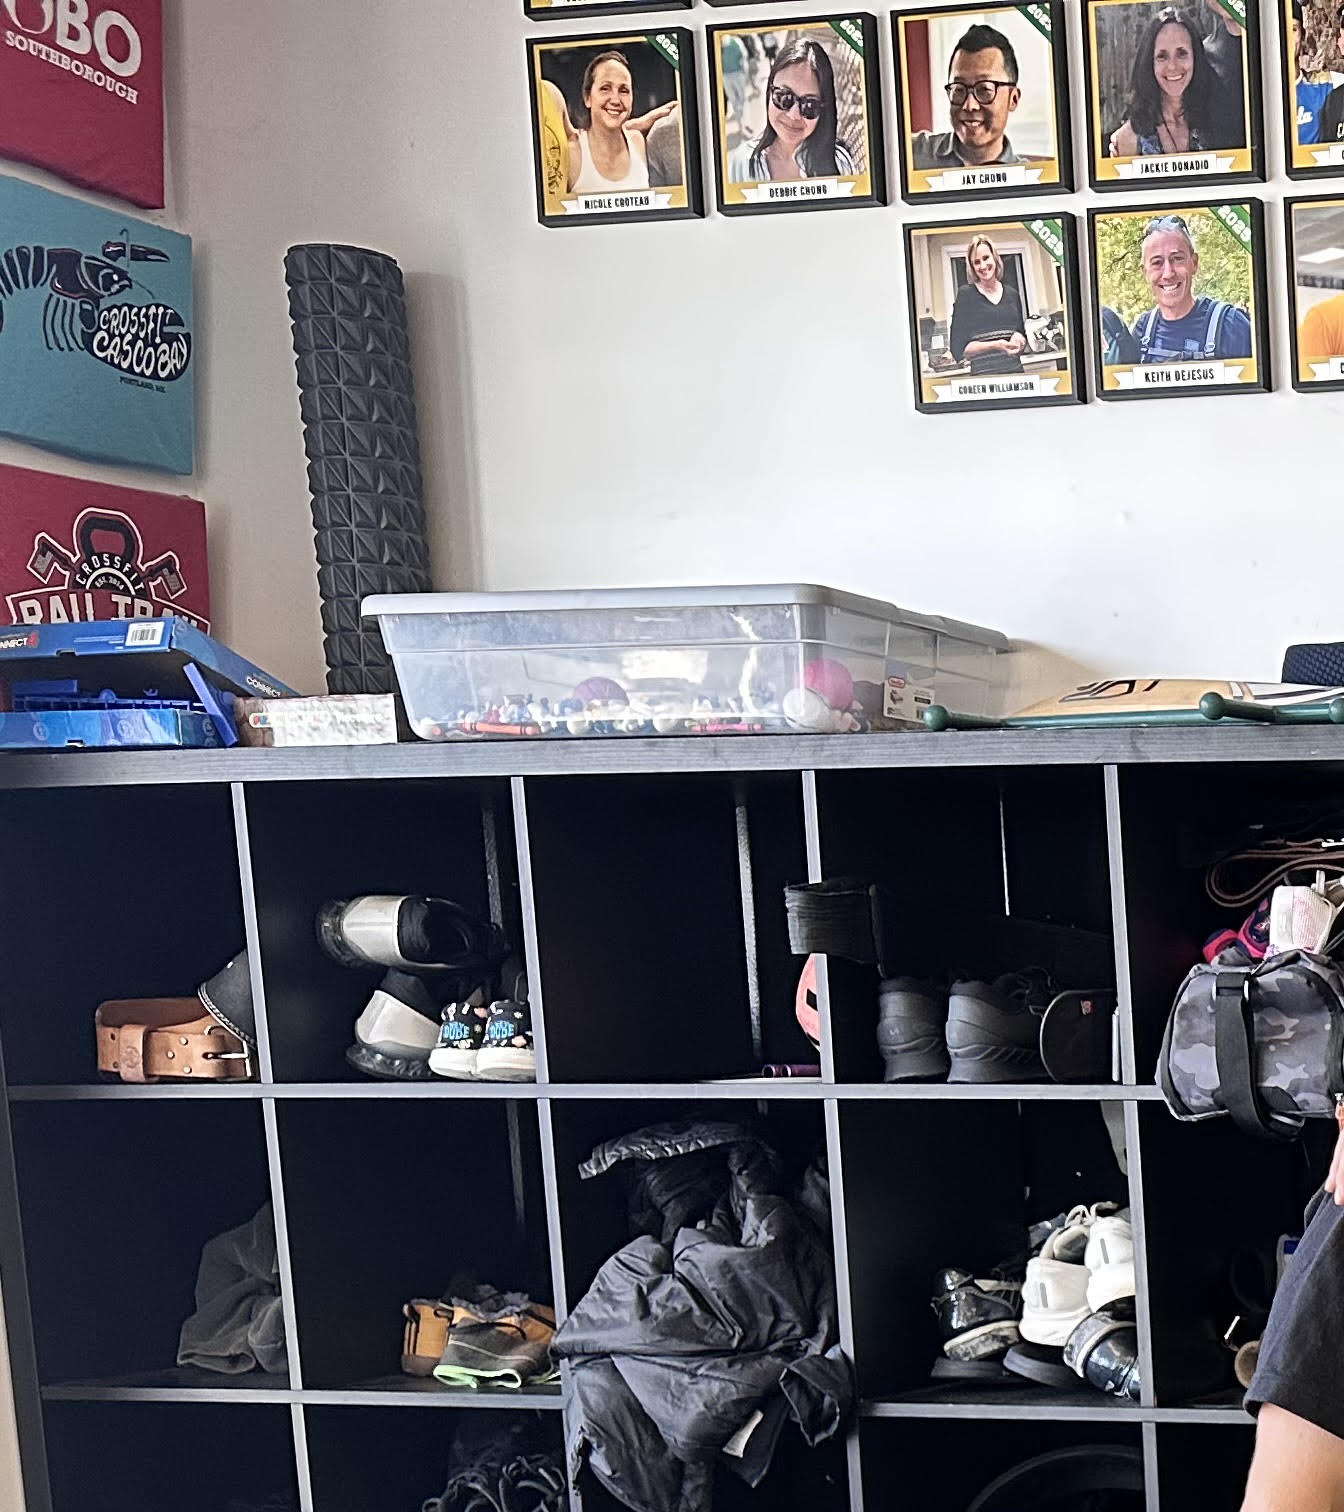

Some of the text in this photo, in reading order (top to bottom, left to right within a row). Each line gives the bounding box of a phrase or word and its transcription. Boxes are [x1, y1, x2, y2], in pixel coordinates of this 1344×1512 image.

[5, 29, 139, 105] SOUTHBOROUGH
[1139, 158, 1210, 175] JACKIE DONADIO
[961, 171, 1008, 186] JAY CHONG
[768, 183, 829, 200] DEBBIE CHONG
[583, 197, 614, 211] NICOLE
[99, 304, 175, 344] CROSSFIT
[92, 330, 189, 379] CASCO BAY
[1143, 367, 1216, 384] KEITH DEJESUS
[987, 380, 1035, 394] WILLIAMSON
[76, 553, 145, 590] CROSSFIT
